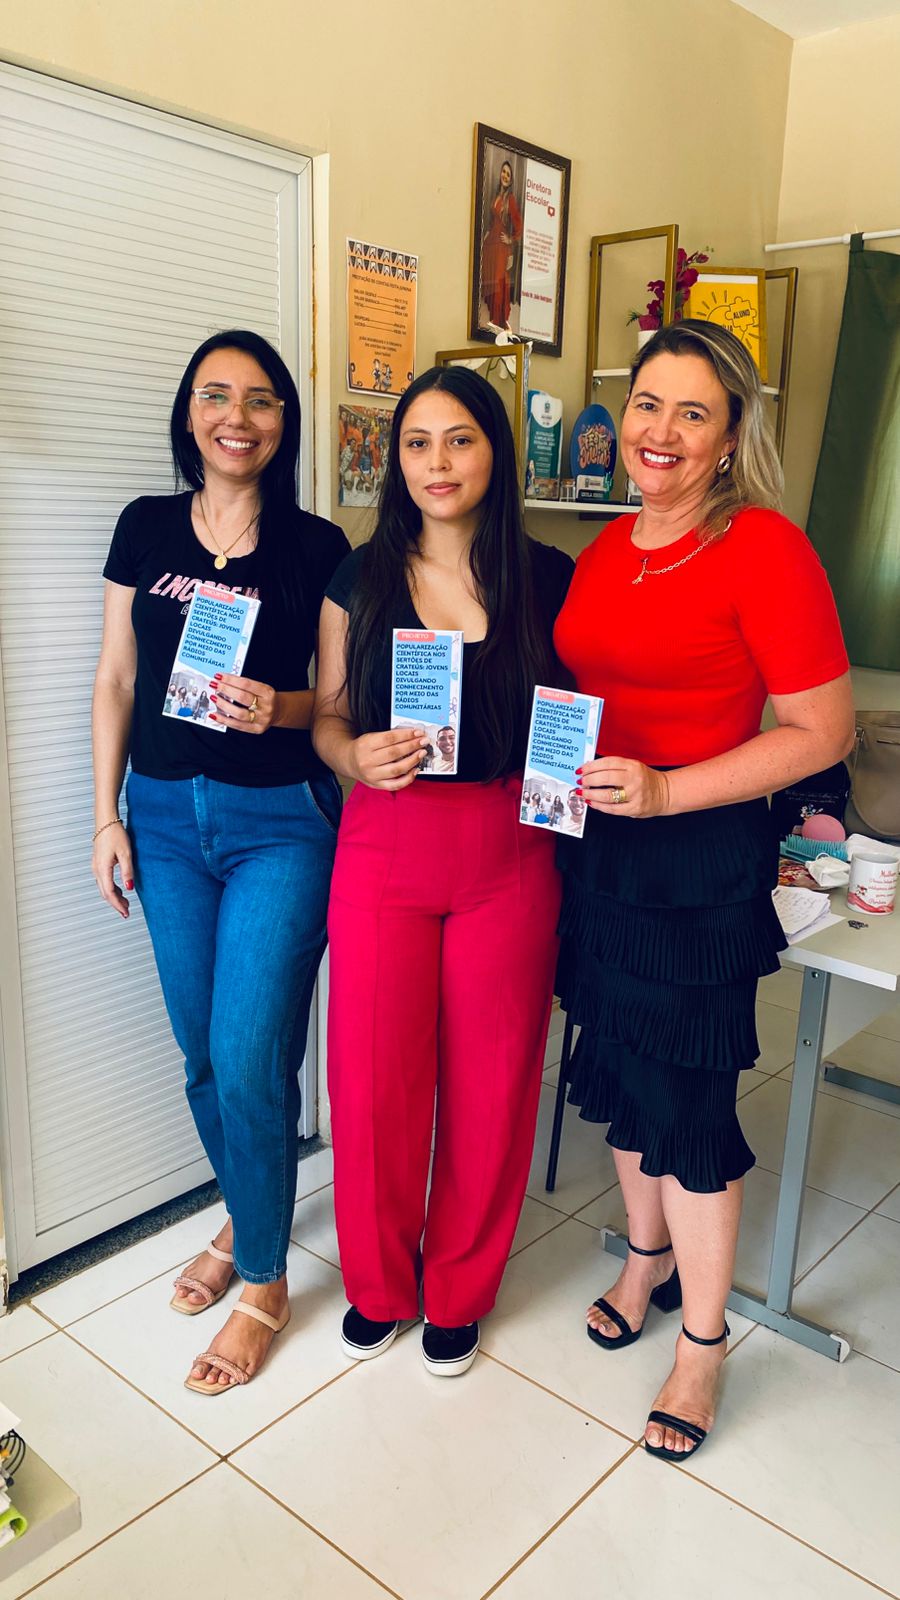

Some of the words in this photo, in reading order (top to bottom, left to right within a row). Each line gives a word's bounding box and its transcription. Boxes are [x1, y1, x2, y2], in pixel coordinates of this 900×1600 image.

[527, 179, 552, 196] Diretora
[527, 192, 549, 206] Escolar
[733, 308, 750, 319] ALUNO
[195, 604, 227, 616] CIENTÍFICA
[197, 598, 244, 615] POPULARIZAÇÃO
[194, 610, 218, 620] SERTÕES
[190, 621, 211, 631] LOCAIS
[192, 615, 217, 627] CRATEÚS:
[218, 623, 240, 633] JOVENS
[188, 628, 226, 642] DIVULGANDO
[187, 634, 232, 650] CONHECIMENTO
[183, 646, 206, 656] RÁDIOS
[198, 643, 213, 652] MEIO
[214, 647, 226, 655] DAS
[182, 652, 225, 668] COMUNITÁRIAS
[536, 707, 569, 717] CIENTÍFICA
[537, 700, 586, 714] POPULARIZAÇÃO
[536, 713, 560, 722] SERTÕES
[535, 720, 561, 729] CRATEÚS:
[534, 732, 572, 744] DIVULGANDO
[533, 739, 579, 752] CONHECIMENTO
[532, 751, 554, 760] RÁDIOS
[531, 758, 574, 770] COMUNITÁRIAS
